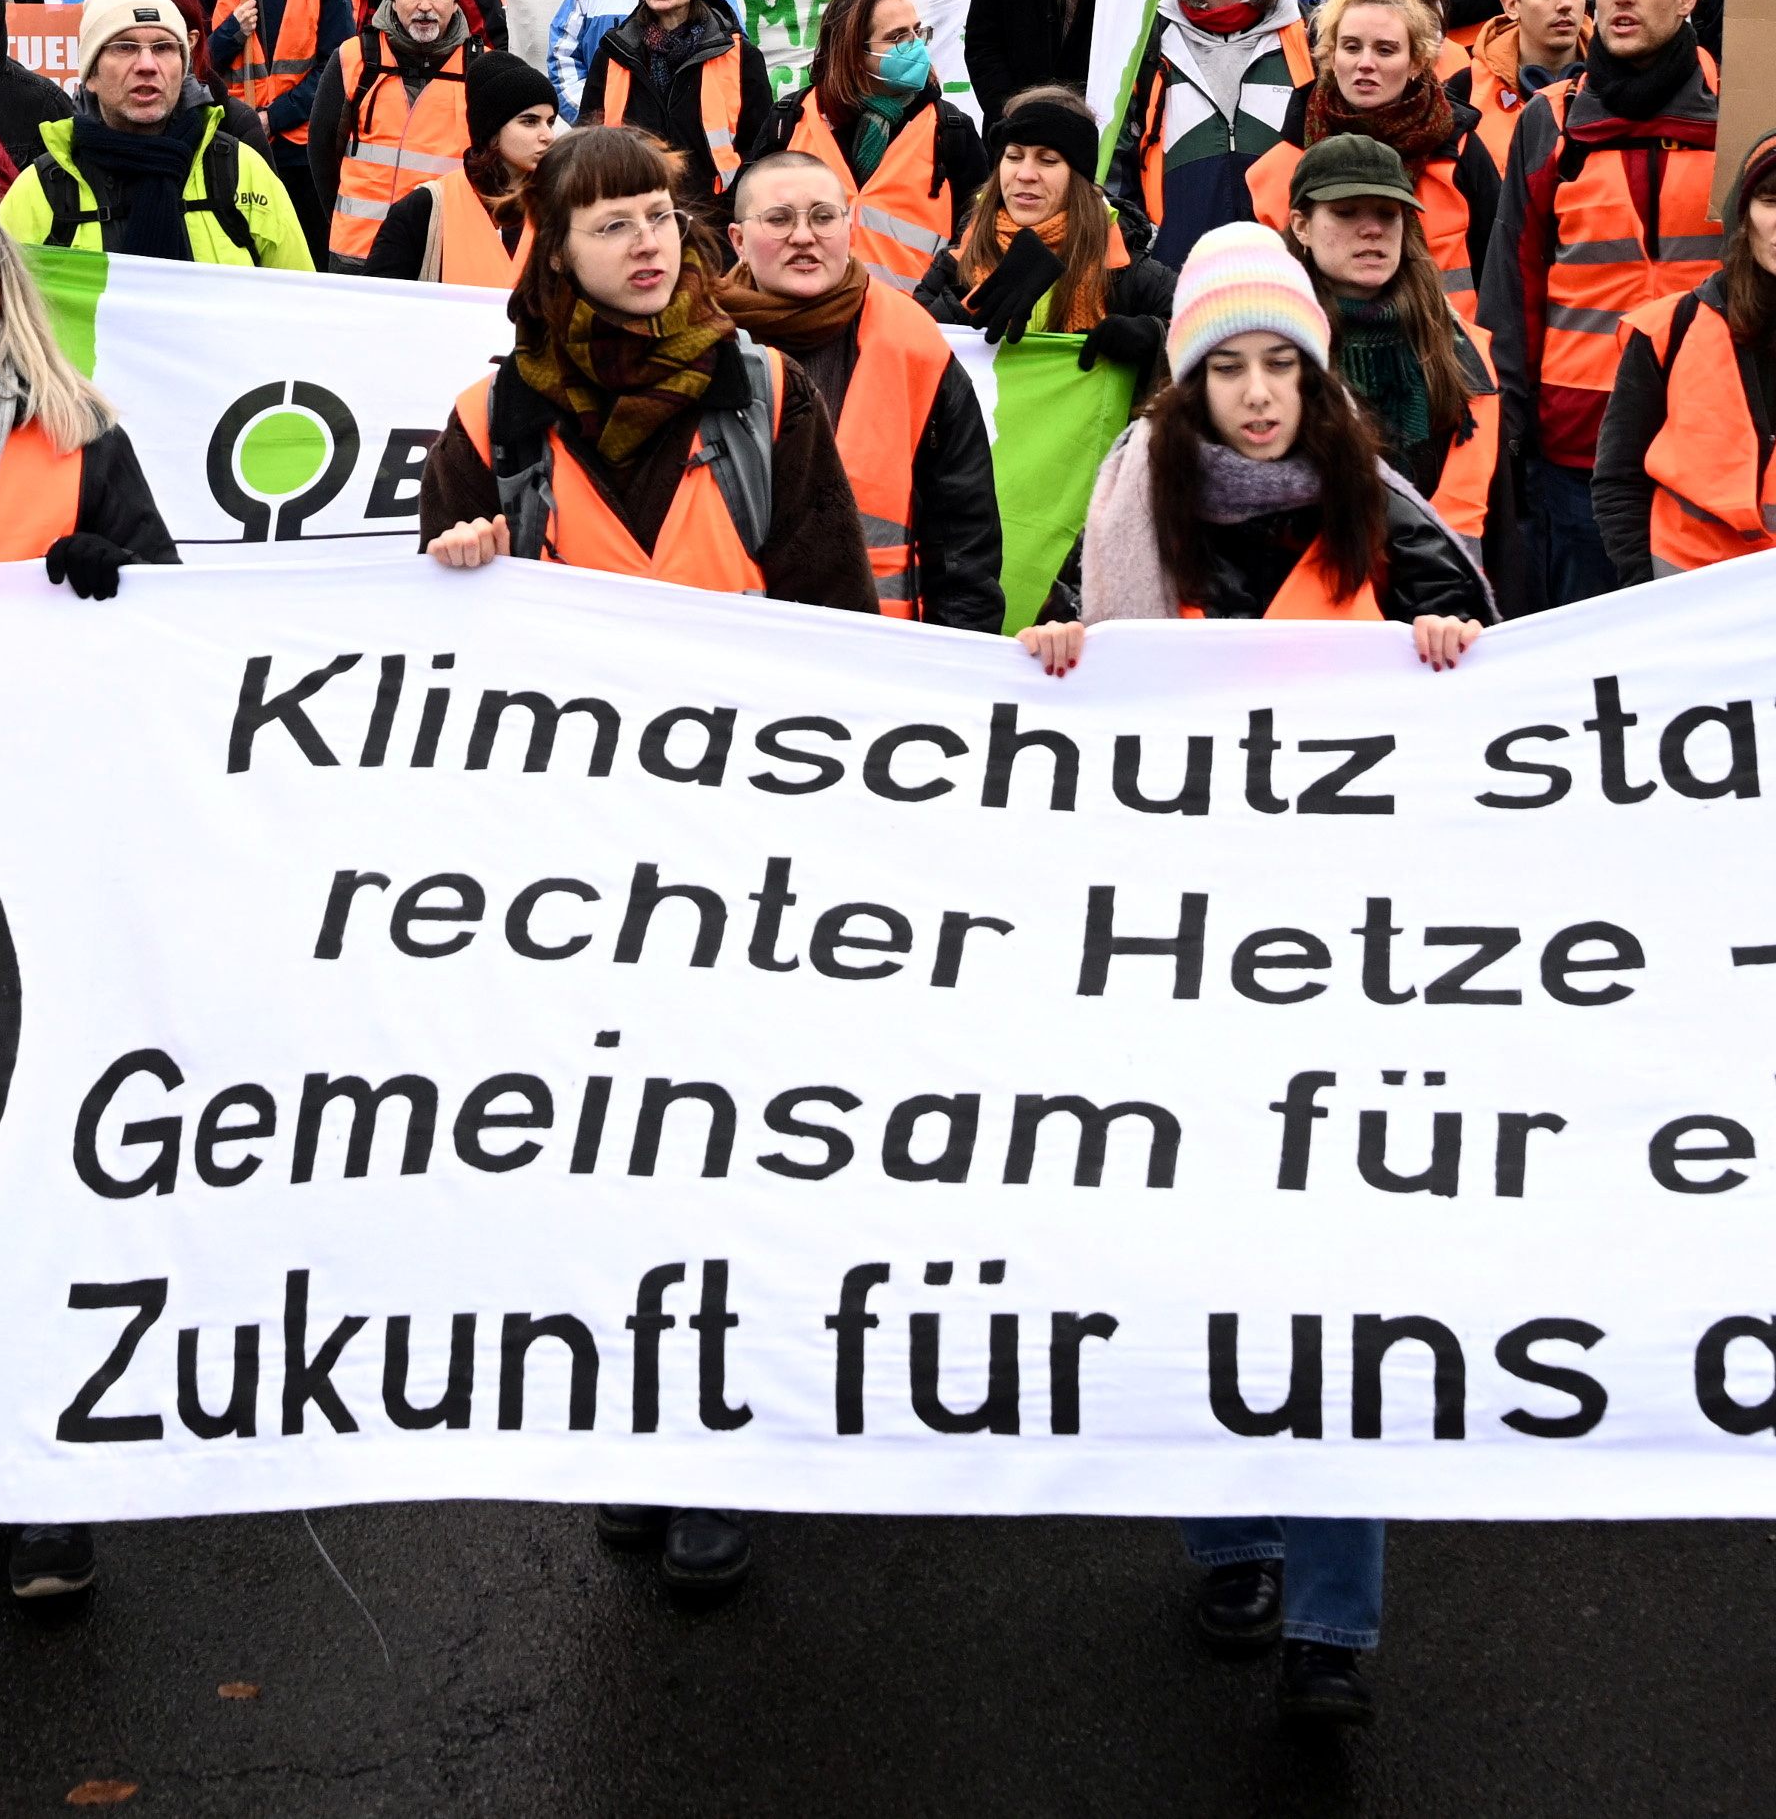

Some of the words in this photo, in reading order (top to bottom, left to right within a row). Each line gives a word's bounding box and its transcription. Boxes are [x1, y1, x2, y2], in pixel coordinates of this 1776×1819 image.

[8, 36, 80, 70] TUEL
[241, 191, 268, 206] BUND
[228, 654, 1395, 816] Klimaschutz
[314, 858, 1015, 988] rechter
[1078, 886, 1645, 1007] Hetze
[72, 1031, 1181, 1200] Gemeinsam
[1270, 1070, 1566, 1199] für
[55, 1260, 753, 1443] Zukunft
[825, 1260, 1119, 1436] für
[1209, 1314, 1608, 1440] uns
